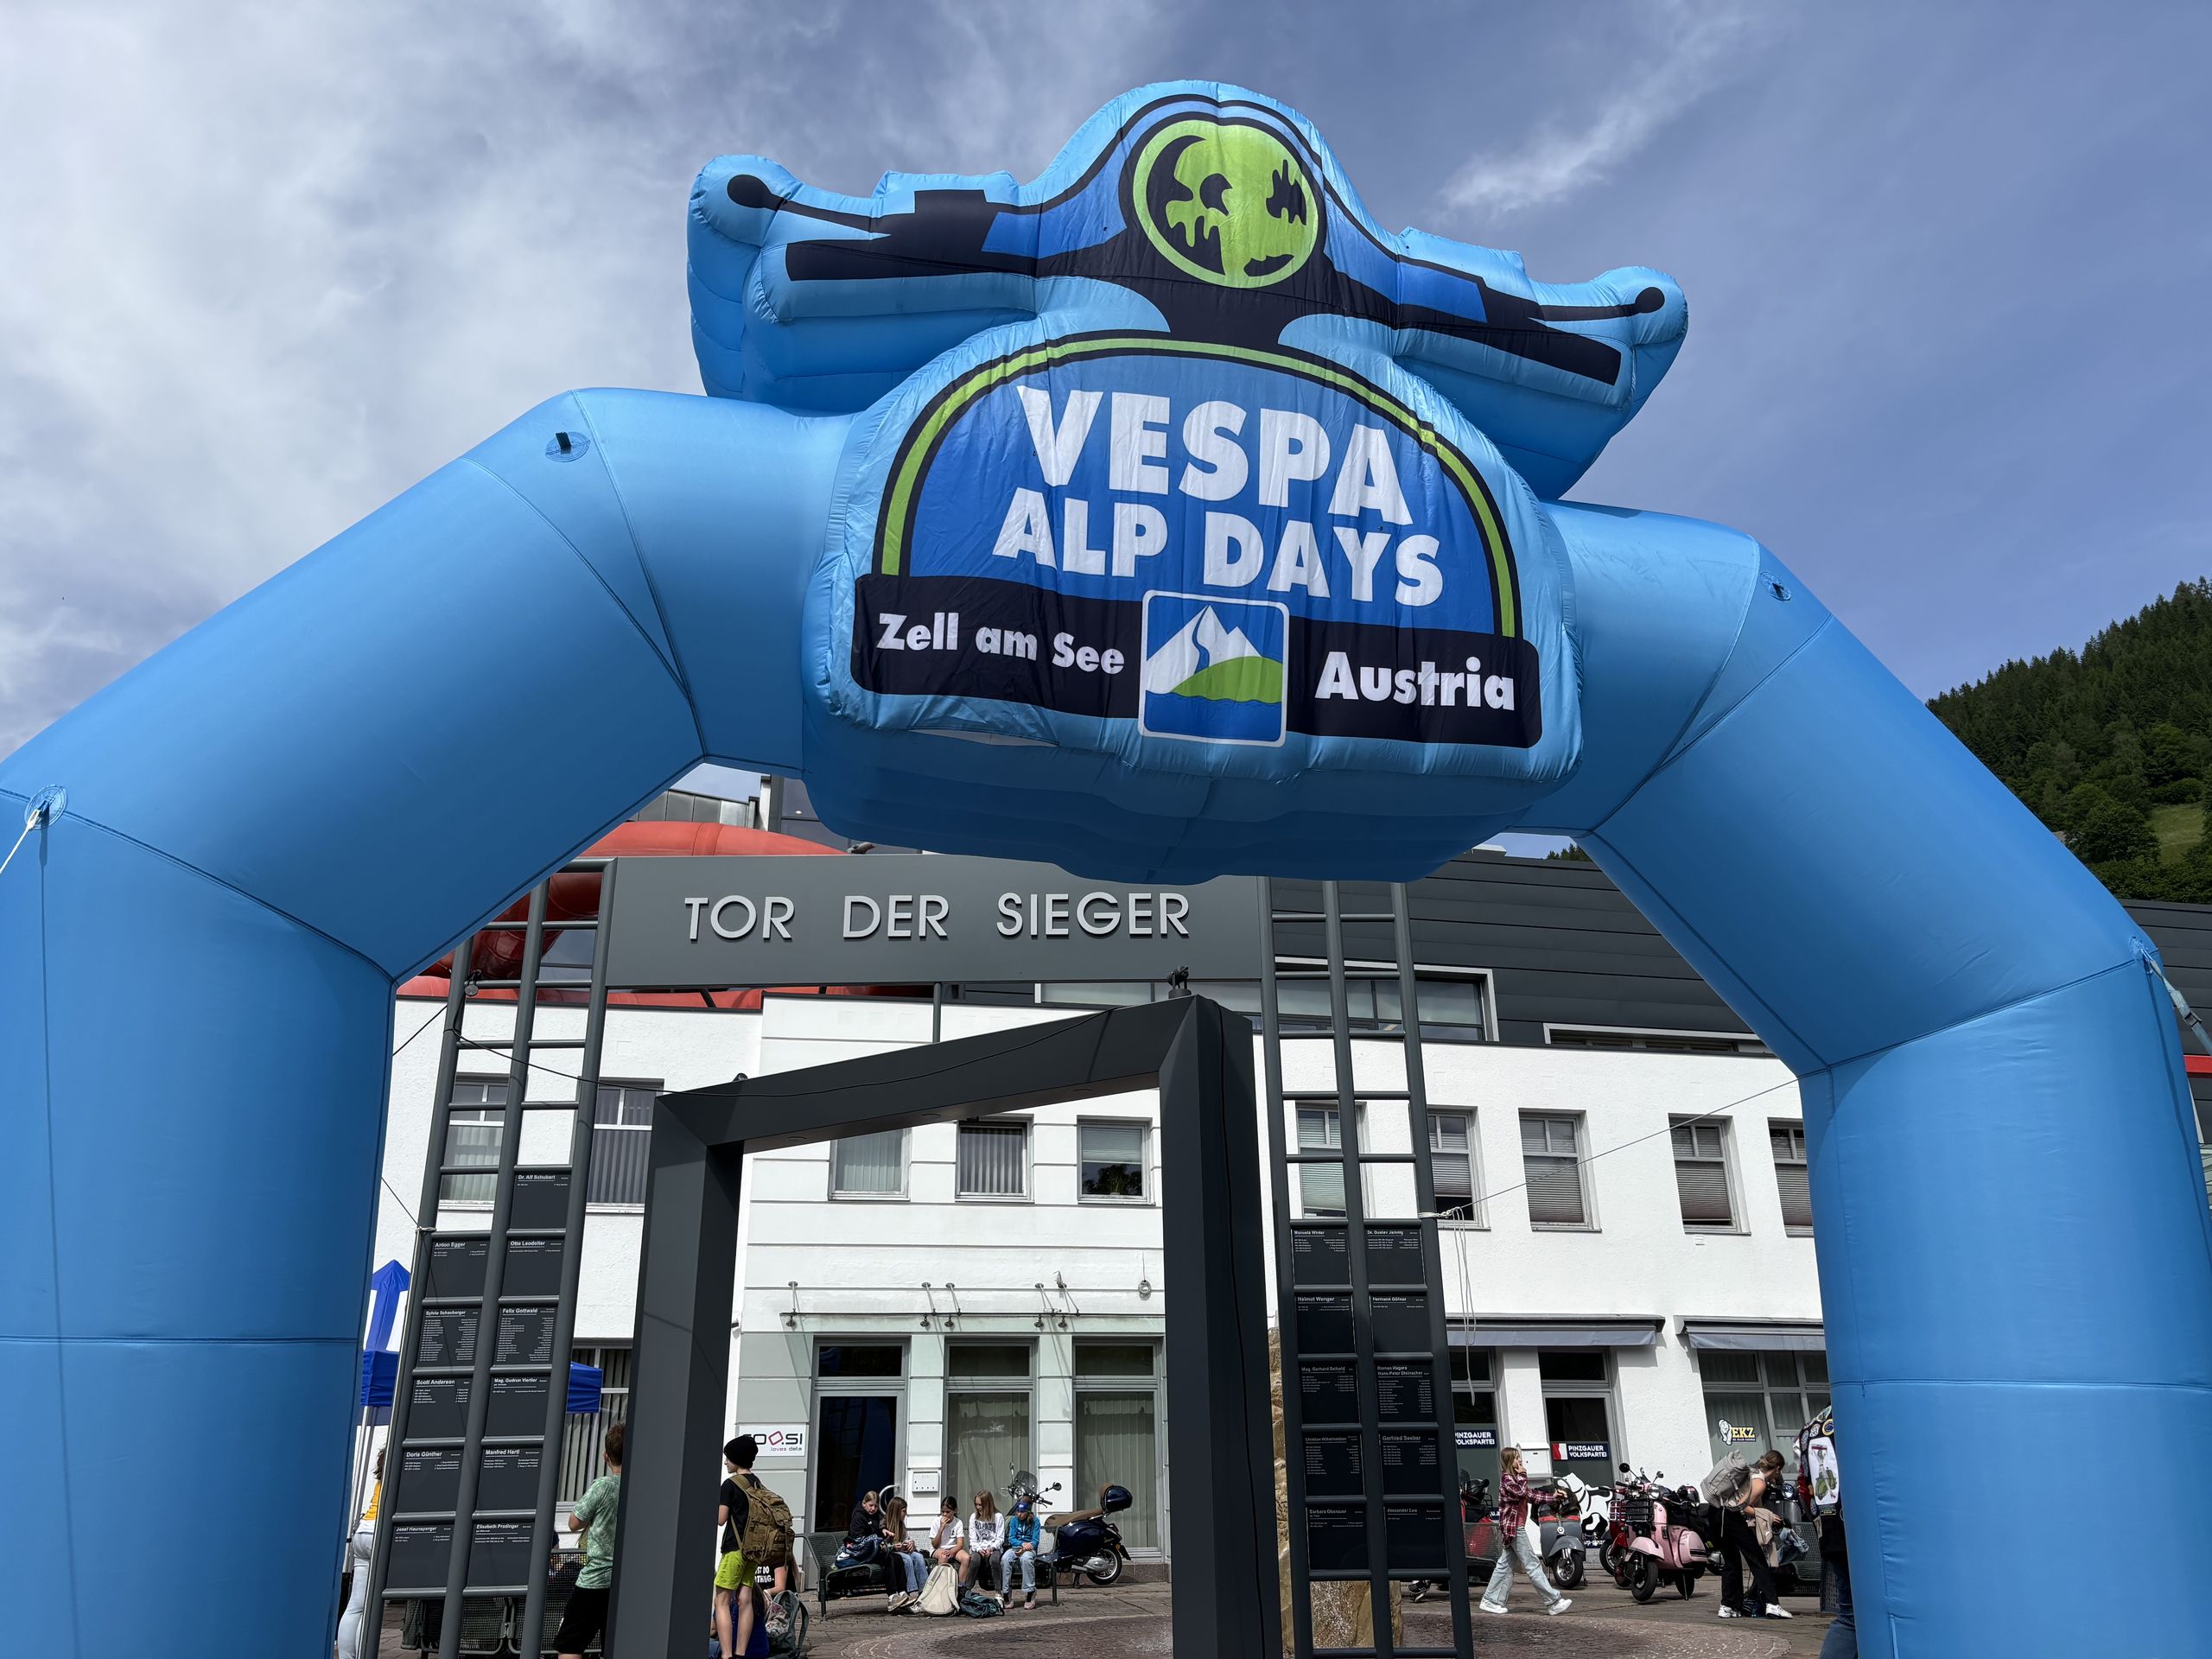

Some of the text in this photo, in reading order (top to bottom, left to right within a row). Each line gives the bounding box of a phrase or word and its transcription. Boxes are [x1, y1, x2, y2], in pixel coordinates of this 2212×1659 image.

[1016, 385, 1414, 525] VESPA
[993, 486, 1443, 607] ALP DAYS
[876, 612, 1516, 711] Zell am See Austria
[684, 891, 1190, 940] TOR DER SIEGER
[1732, 1427, 1756, 1439] EKZ
